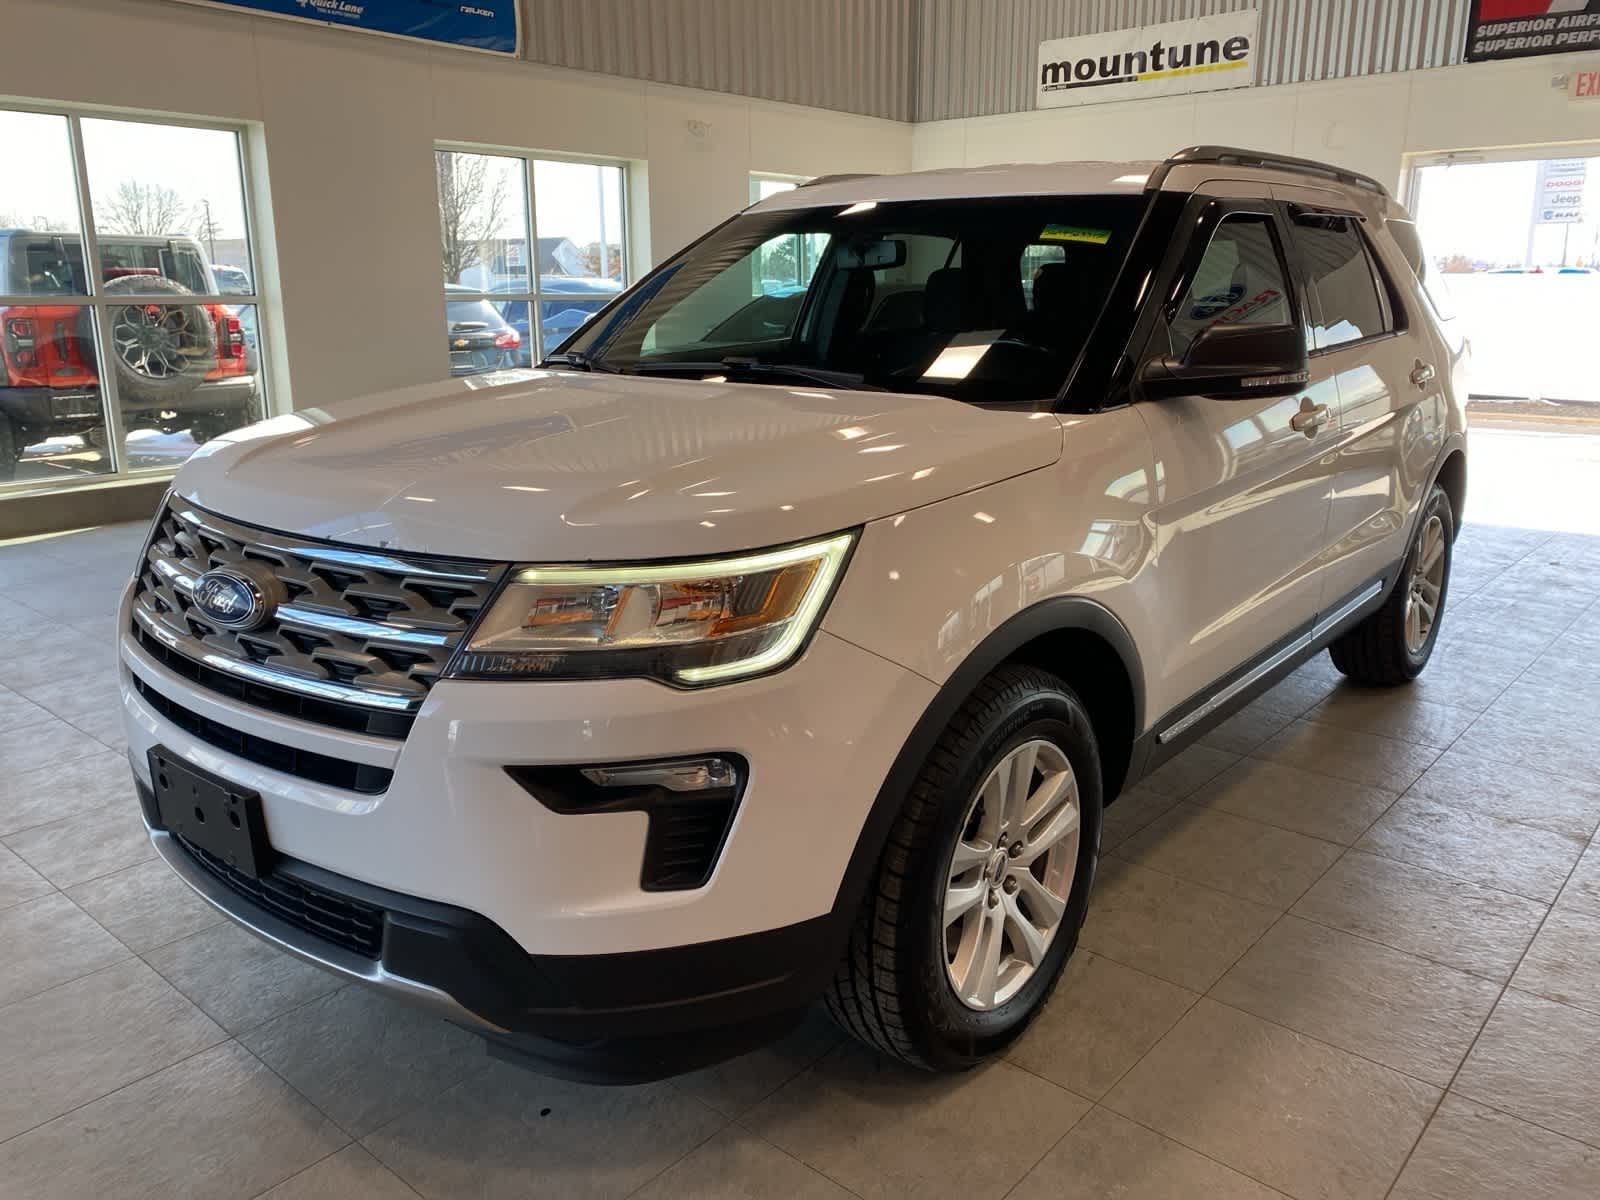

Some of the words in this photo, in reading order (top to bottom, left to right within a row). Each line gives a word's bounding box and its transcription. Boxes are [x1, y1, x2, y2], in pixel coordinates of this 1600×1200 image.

[310, 0, 339, 10] Quick
[339, 1, 364, 14] Lane
[1476, 18, 1557, 38] SUPERIOR
[1473, 34, 1554, 53] SUPERIOR
[1556, 29, 1600, 45] PERF
[1041, 36, 1250, 84] mountune
[1551, 194, 1582, 205] Jeep
